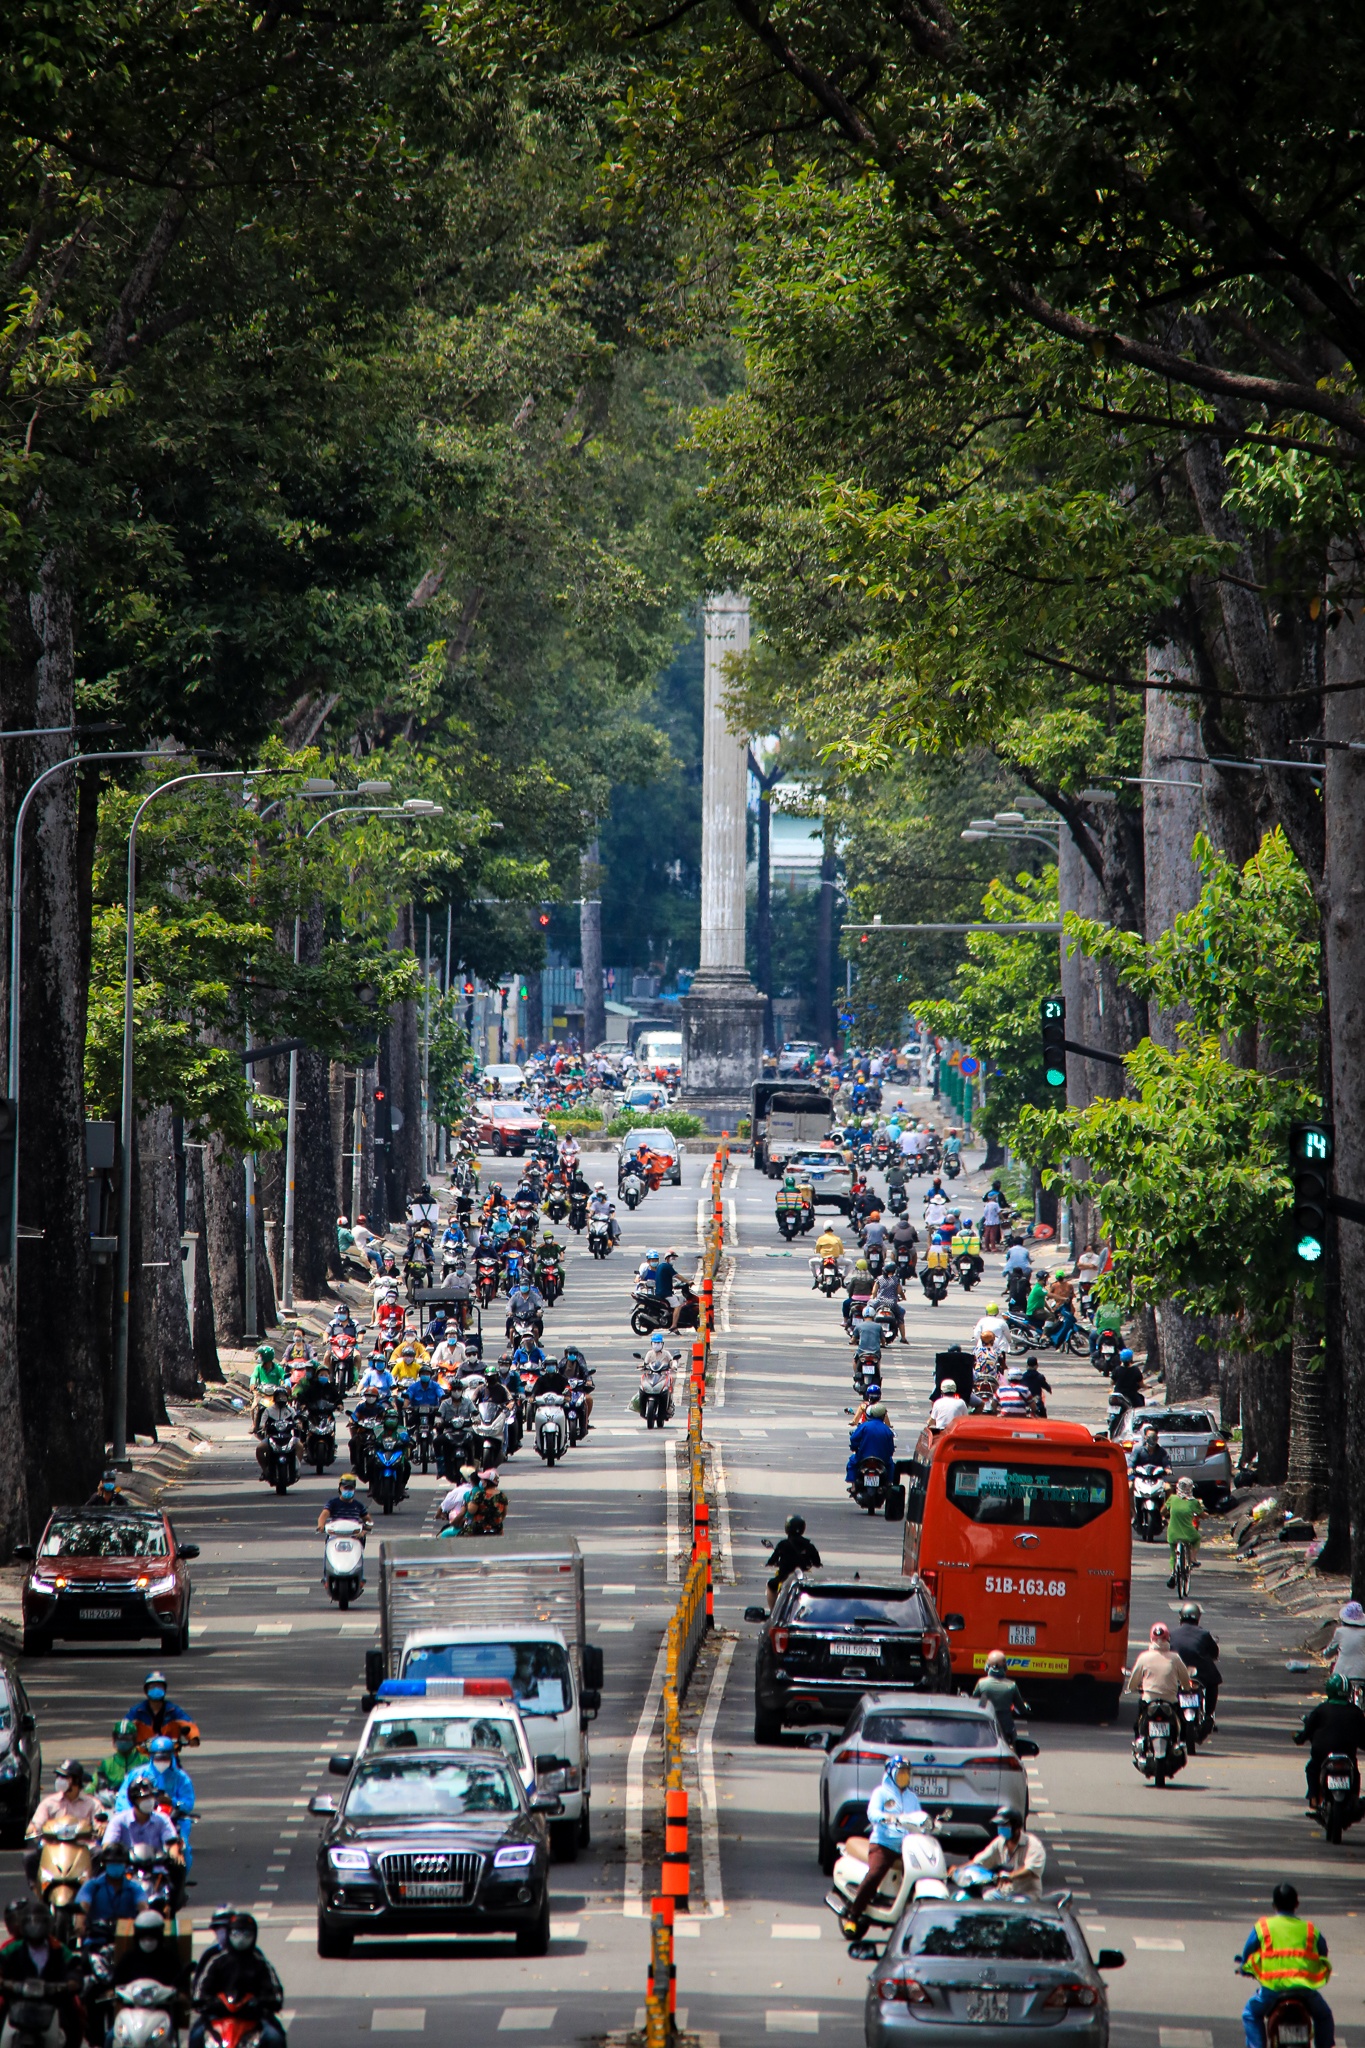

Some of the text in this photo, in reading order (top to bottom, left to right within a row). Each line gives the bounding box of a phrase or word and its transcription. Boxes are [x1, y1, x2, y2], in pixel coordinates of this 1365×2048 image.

[1307, 1133, 1326, 1158] 14
[1005, 1473, 1033, 1485] CÔNG
[1035, 1475, 1050, 1485] TY
[1042, 1487, 1089, 1502] TRANG
[985, 1577, 1066, 1597] 51B-163.68
